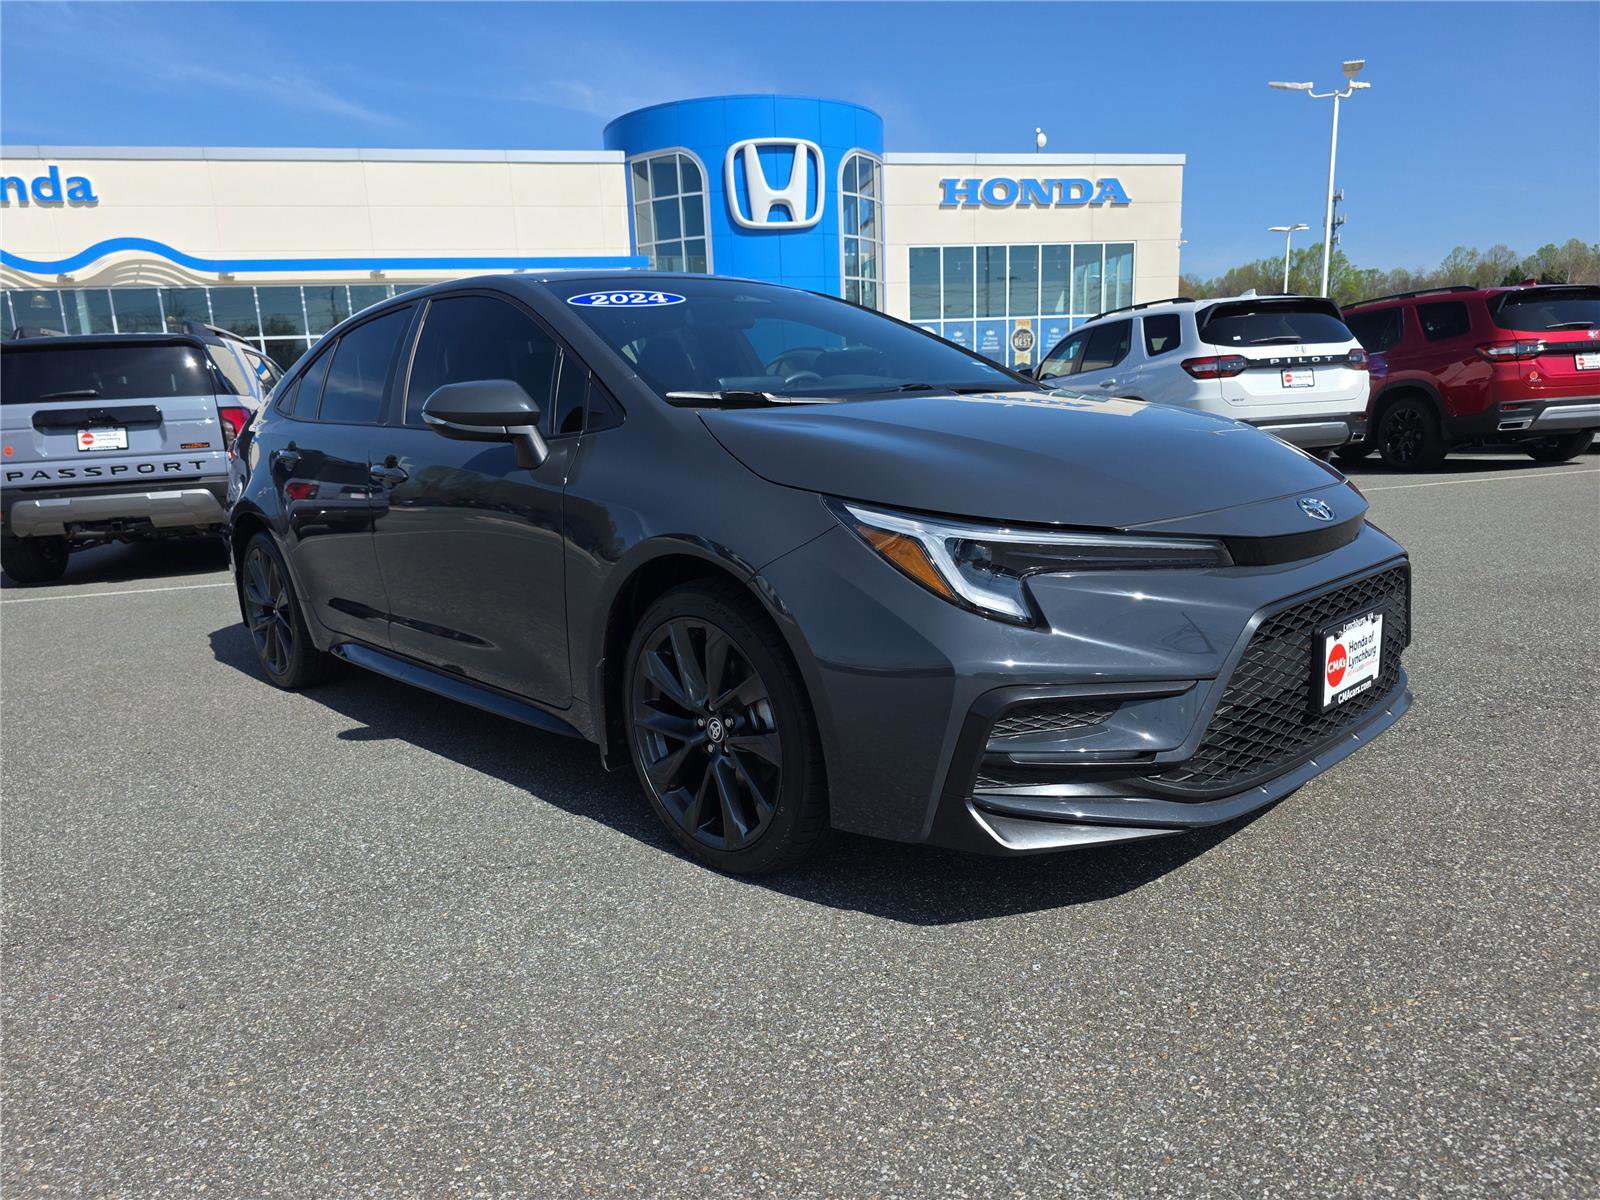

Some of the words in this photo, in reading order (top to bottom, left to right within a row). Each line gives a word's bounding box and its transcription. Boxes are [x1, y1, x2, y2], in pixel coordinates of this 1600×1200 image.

[0, 165, 98, 207] nda
[939, 177, 1132, 209] HONDA
[590, 292, 668, 305] 2024
[1270, 355, 1333, 365] PILOT
[6, 460, 206, 482] PASSPORT
[1348, 635, 1368, 654] Honda
[1368, 630, 1375, 644] of
[1348, 645, 1377, 670] Lynchburg
[1337, 680, 1372, 705] CMAcars.com
